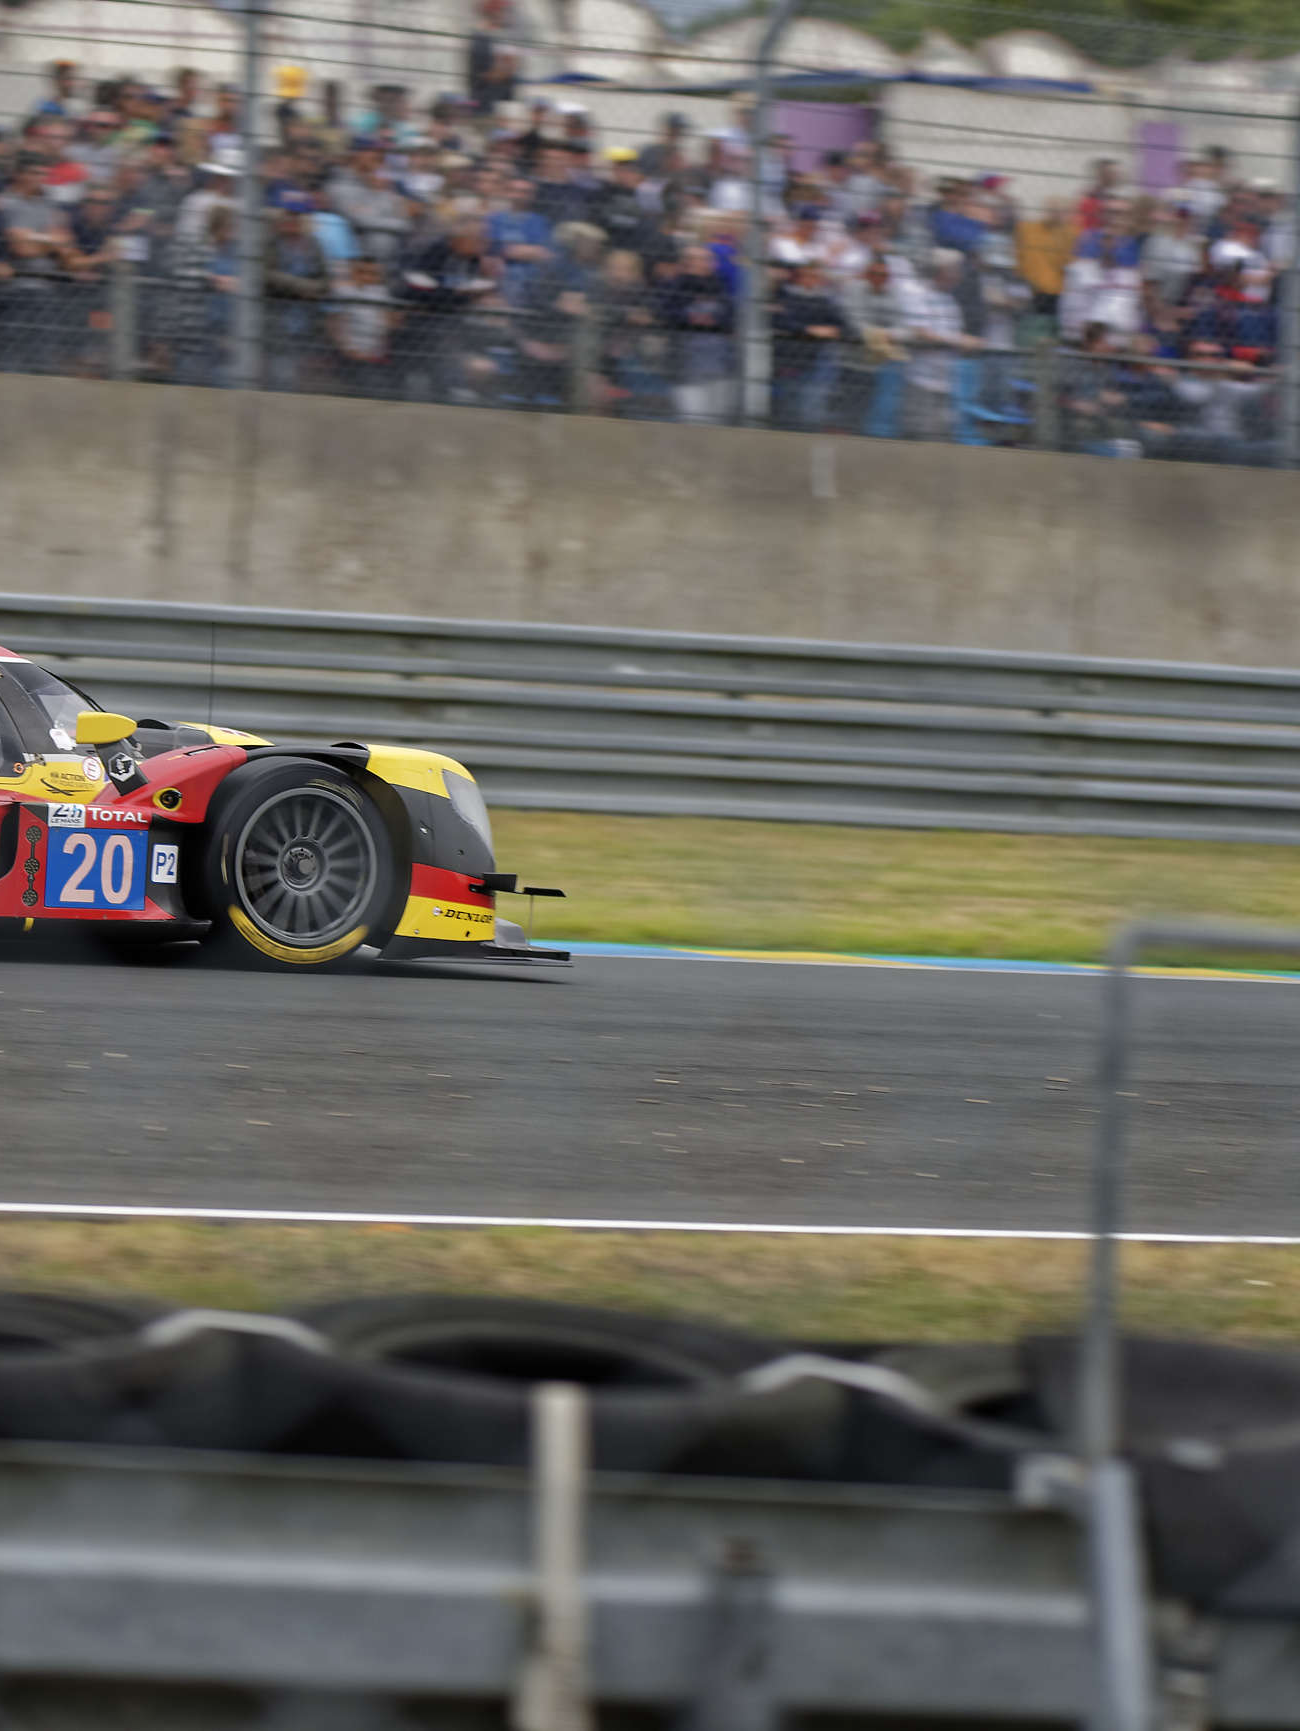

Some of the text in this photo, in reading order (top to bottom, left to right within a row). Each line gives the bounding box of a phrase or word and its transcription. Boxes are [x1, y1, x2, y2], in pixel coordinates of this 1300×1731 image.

[87, 807, 149, 823] TOTAL
[59, 833, 134, 904] 20
[156, 852, 176, 876] P2
